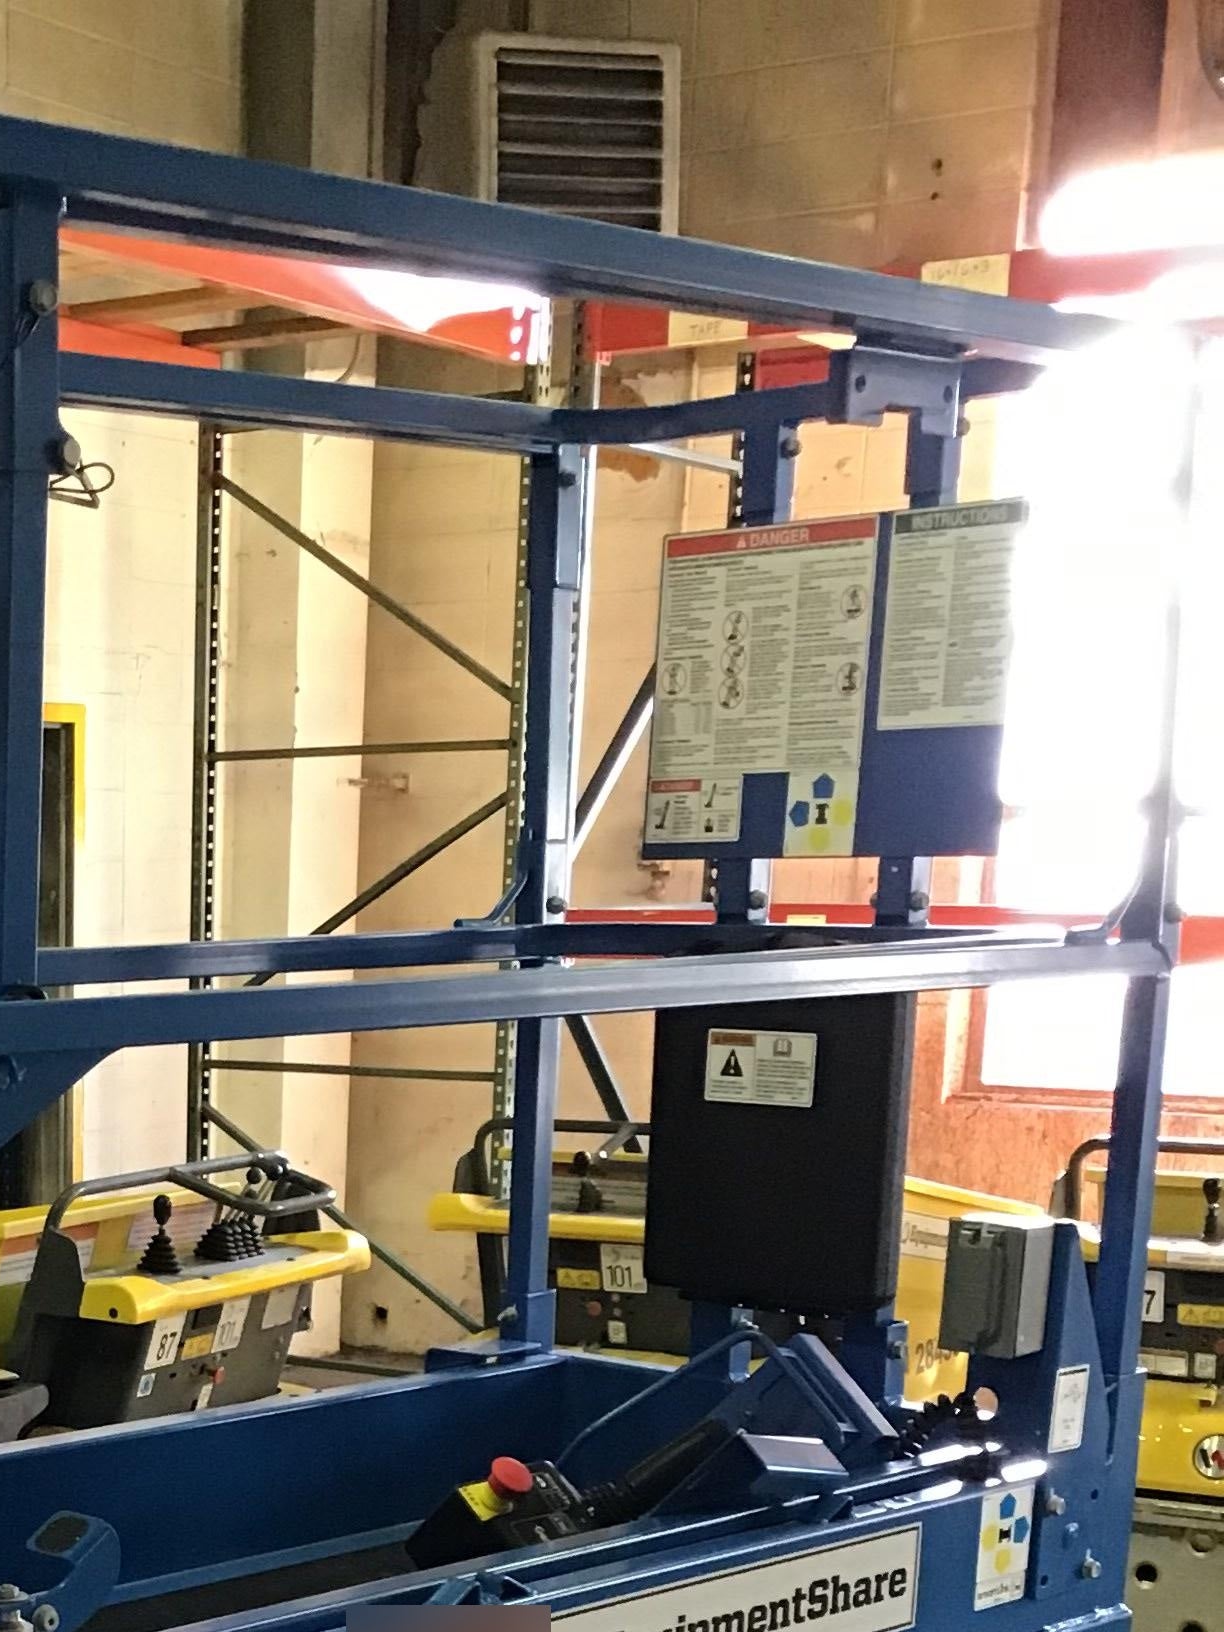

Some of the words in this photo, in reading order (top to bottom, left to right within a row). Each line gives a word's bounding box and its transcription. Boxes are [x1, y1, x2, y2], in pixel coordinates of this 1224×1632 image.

[912, 505, 1009, 530] INSTRUCTIONS
[749, 527, 810, 549] DANGER
[156, 1331, 177, 1361] 87
